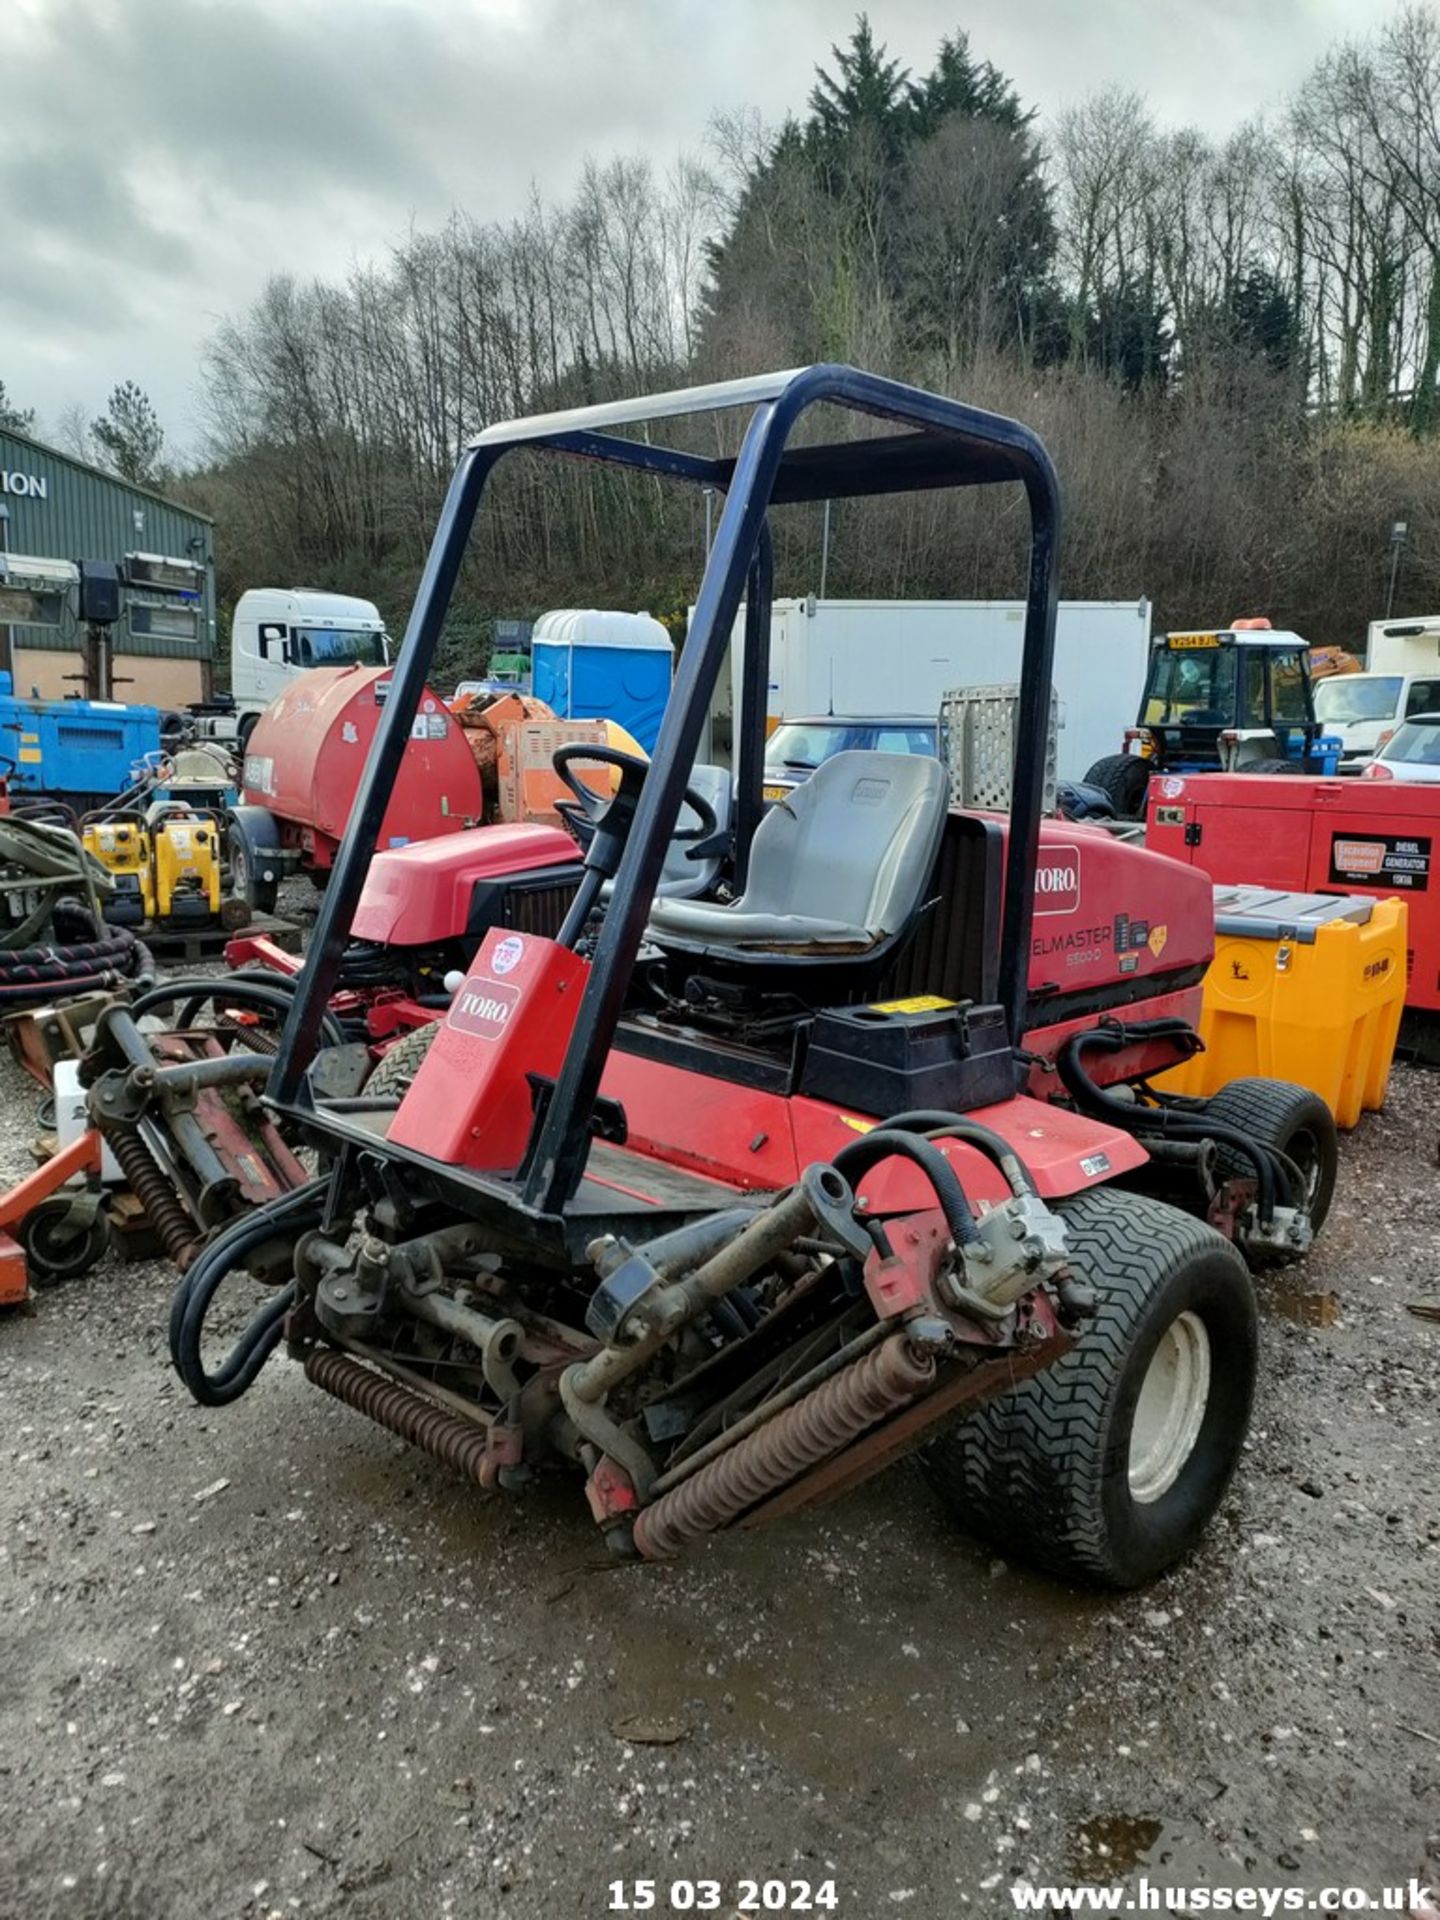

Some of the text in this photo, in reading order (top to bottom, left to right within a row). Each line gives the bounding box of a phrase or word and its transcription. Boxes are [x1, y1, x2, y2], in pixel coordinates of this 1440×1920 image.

[1, 471, 47, 498] ION
[1395, 841, 1419, 853] DIESEL
[1385, 856, 1426, 870] GENERATOR
[461, 993, 508, 1022] TORO
